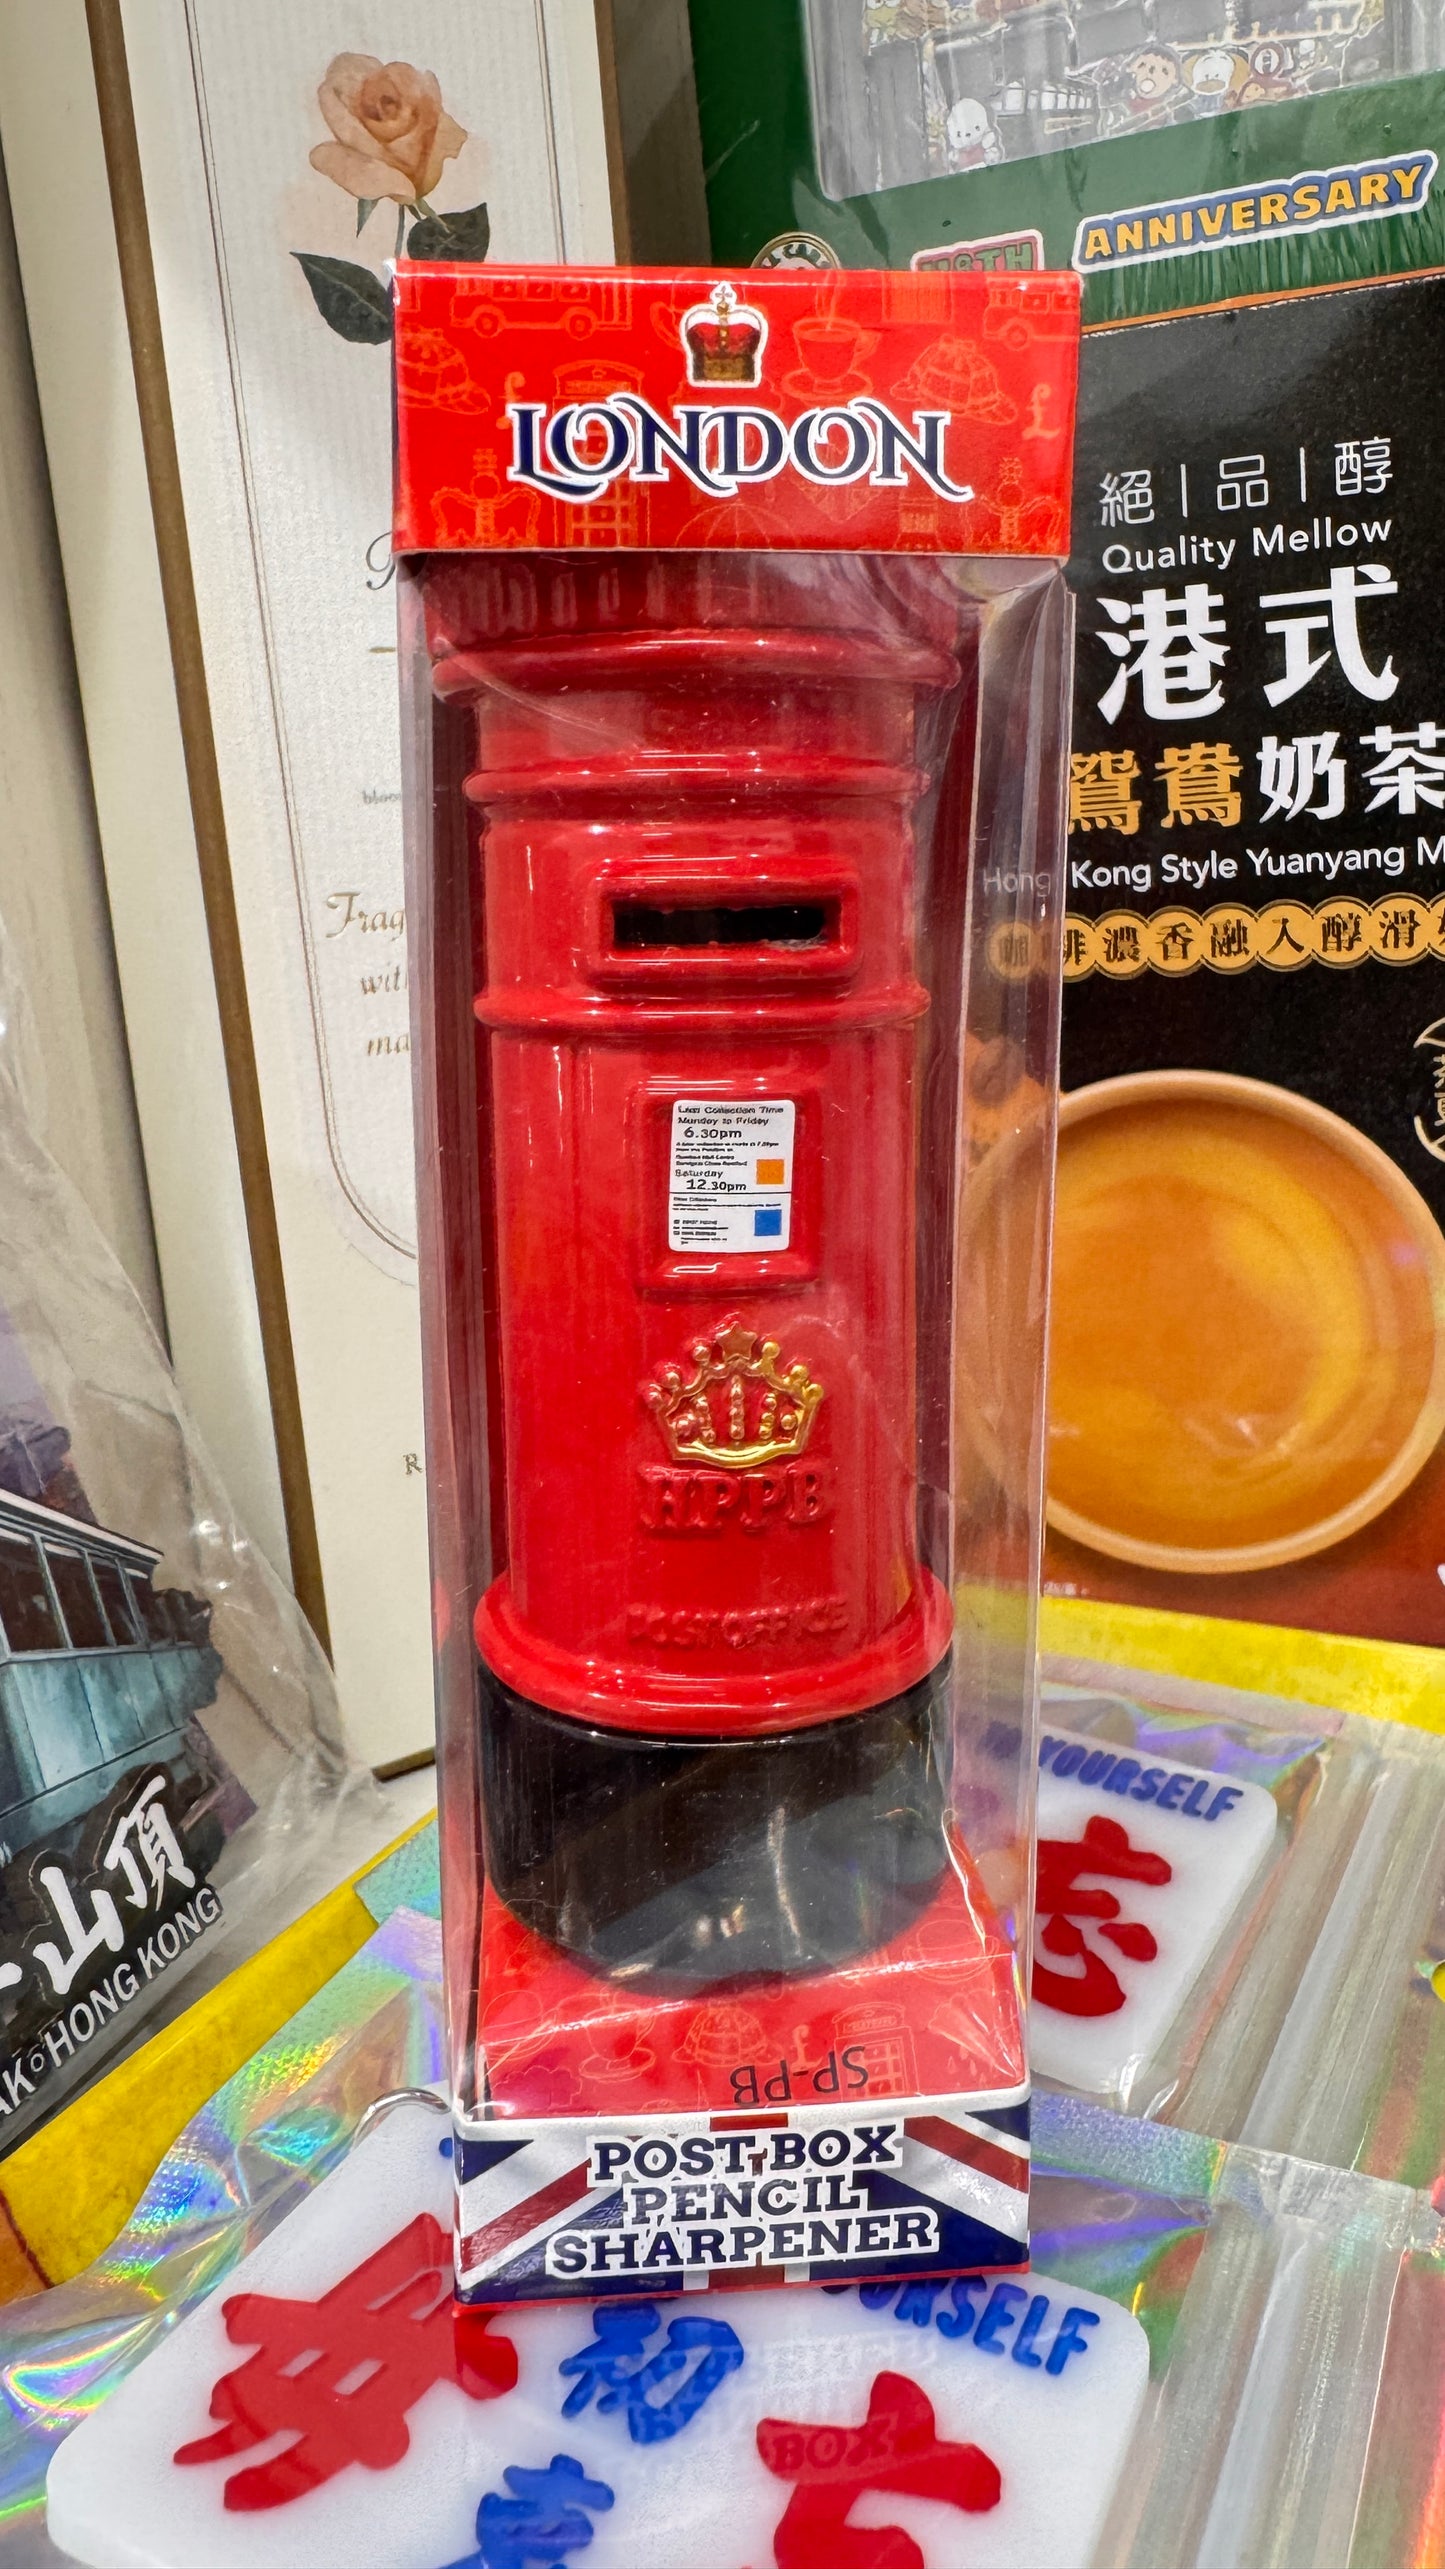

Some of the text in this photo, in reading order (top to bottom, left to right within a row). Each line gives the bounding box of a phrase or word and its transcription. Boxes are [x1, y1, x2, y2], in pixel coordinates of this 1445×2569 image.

[1085, 165, 1424, 260] ANNIVERSARY
[507, 394, 974, 502] LONDON
[1102, 517, 1392, 574] Quality Mellow
[1095, 564, 1399, 725] 港式
[1068, 722, 1445, 835] 鴛鴦奶茶
[983, 867, 1050, 898] Hong
[1071, 859, 1151, 893] Kong
[1161, 850, 1238, 889] Style
[1246, 845, 1405, 880] Yuanyang
[684, 1127, 742, 1140] 6.30pm
[675, 1168, 723, 1179] Saturday
[686, 1179, 748, 1193] 12.30pm
[1038, 1735, 1244, 1821] YOURSELF
[44, 1963, 140, 2067] HONG
[139, 1887, 220, 1981] KONG
[729, 2045, 869, 2106] SP-PB
[624, 2173, 865, 2226] PENCIL
[547, 2208, 937, 2276] SHARPENER
